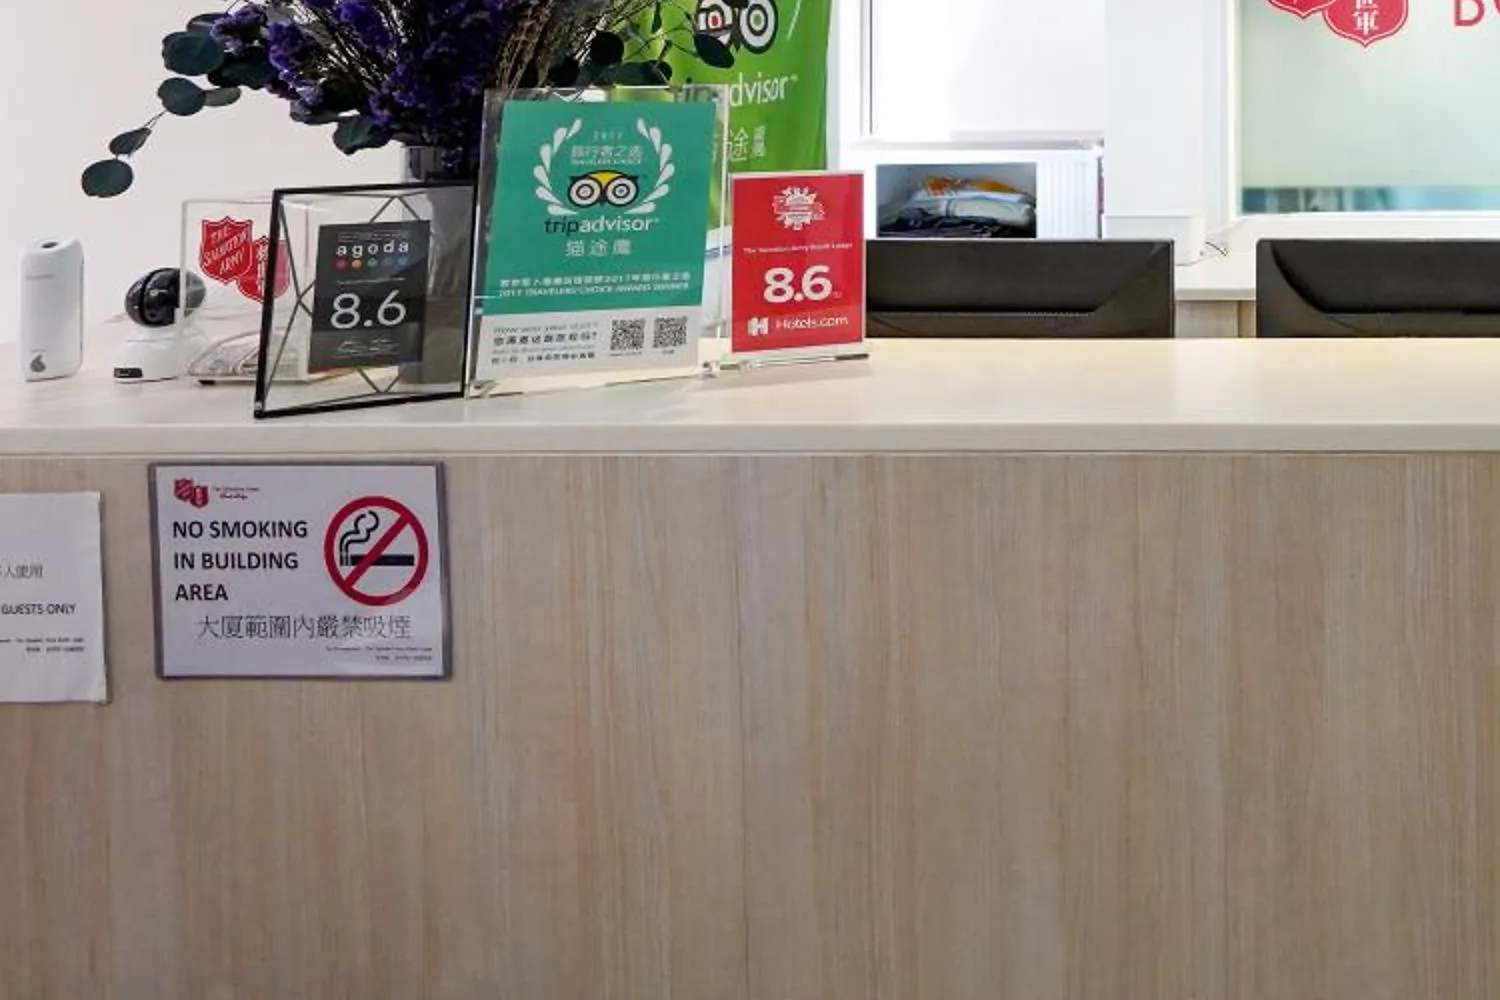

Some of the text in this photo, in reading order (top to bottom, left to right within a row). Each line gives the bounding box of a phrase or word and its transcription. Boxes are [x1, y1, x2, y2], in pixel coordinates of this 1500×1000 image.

[544, 215, 652, 236] tripadvisor
[336, 240, 409, 258] agoda
[763, 265, 833, 303] 8.6
[330, 289, 407, 329] 8.6
[173, 520, 308, 539] NO SMOKING
[174, 552, 299, 570] IN BUILDING
[175, 583, 229, 601] AREA
[1, 603, 76, 615] GUESTS ONLY
